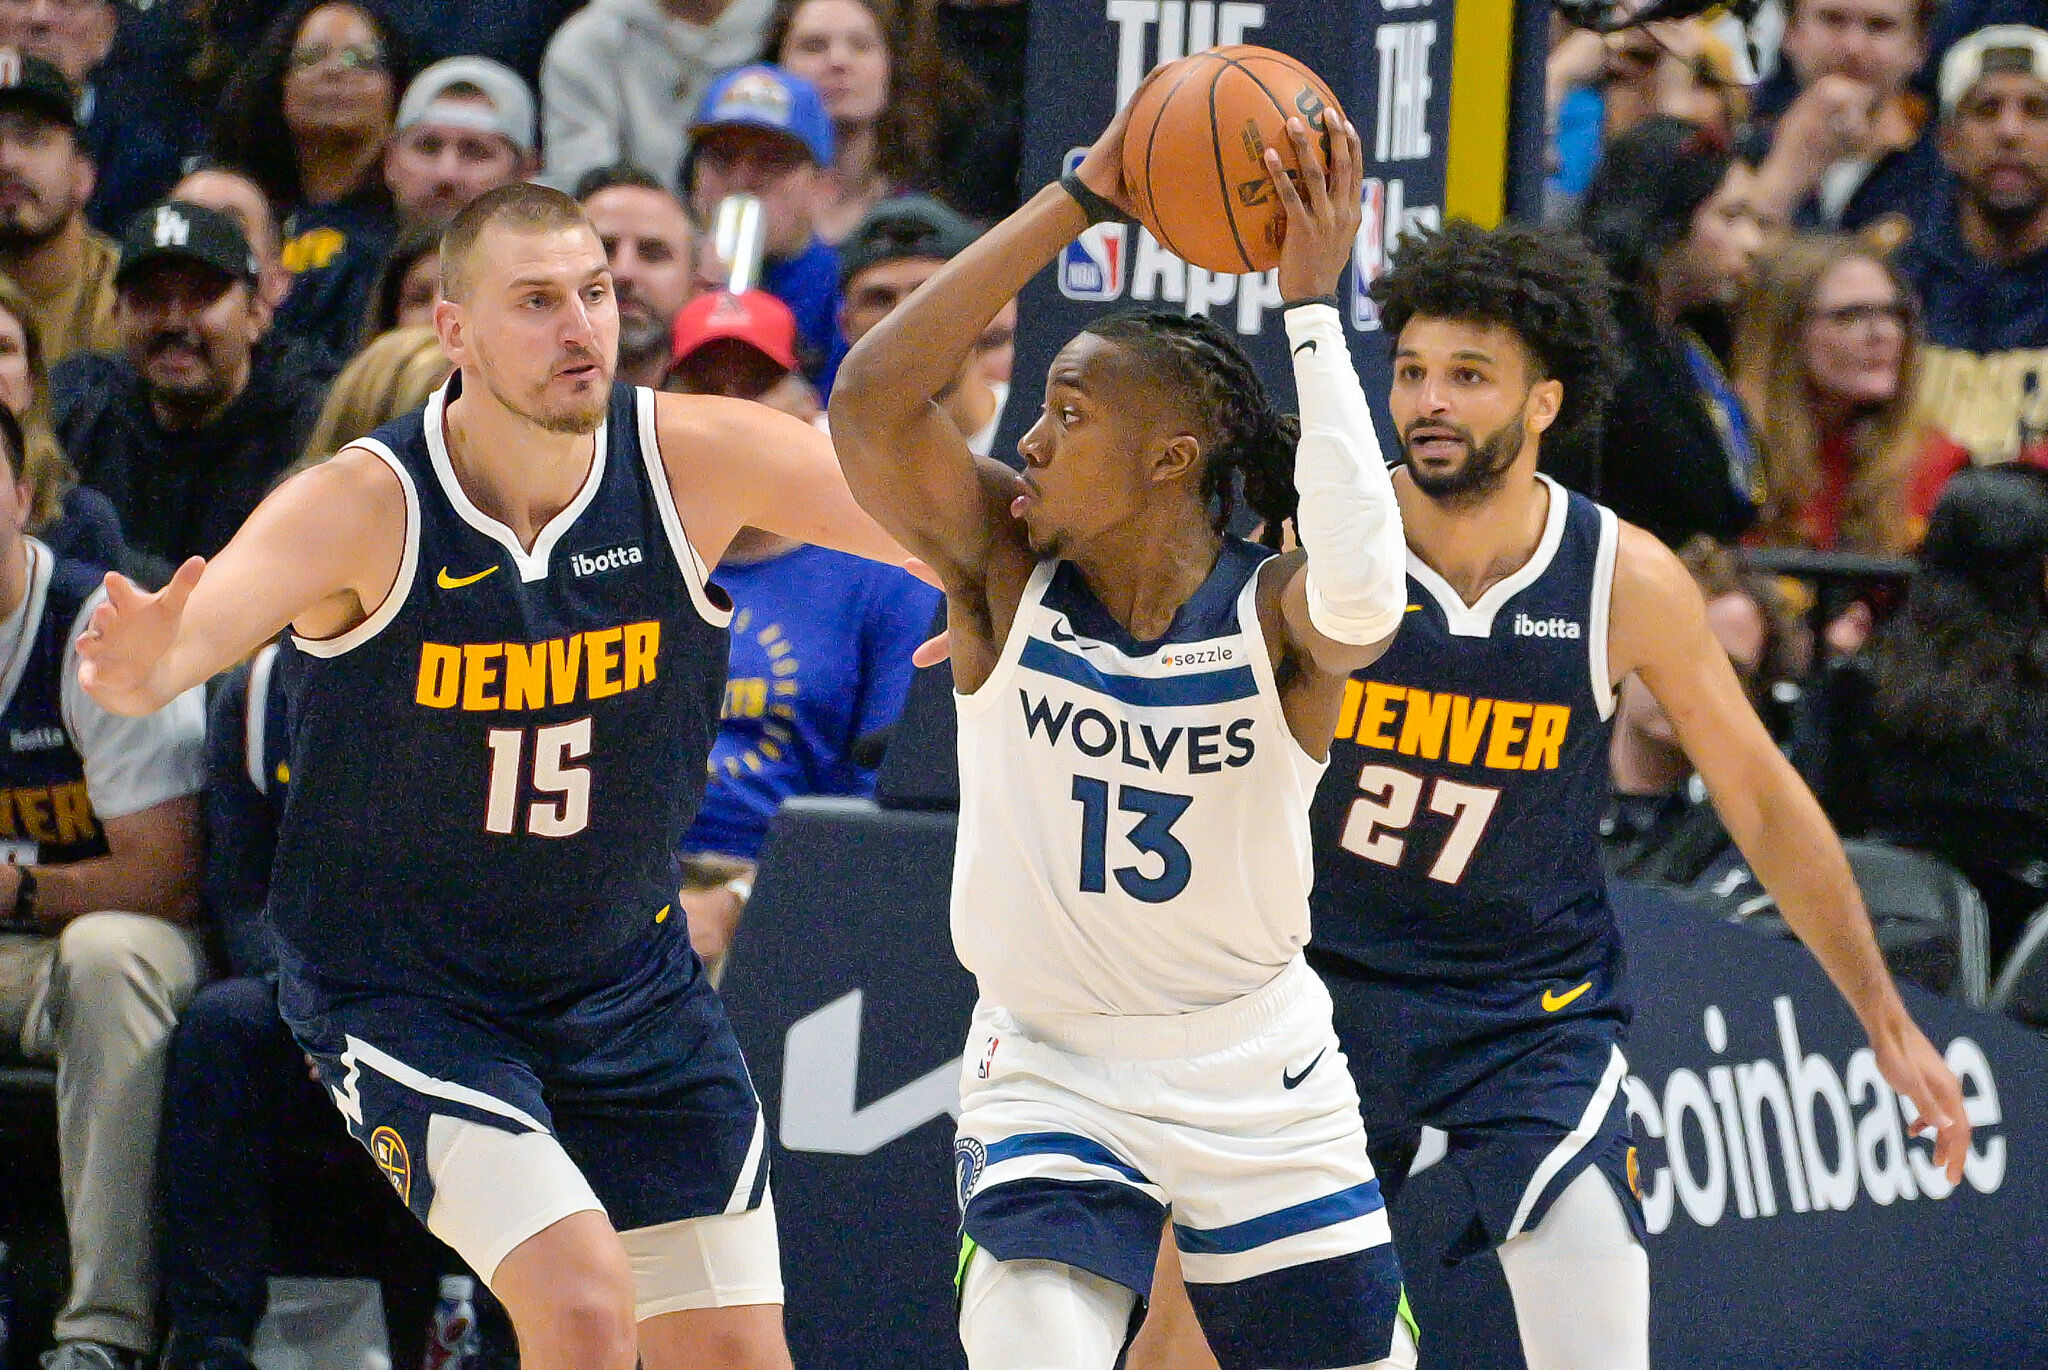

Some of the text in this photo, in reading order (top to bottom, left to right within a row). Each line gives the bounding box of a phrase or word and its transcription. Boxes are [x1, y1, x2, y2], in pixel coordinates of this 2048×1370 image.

[571, 546, 642, 577] ibotta
[415, 620, 660, 711] DENVER
[1174, 645, 1233, 666] sezzle
[1514, 612, 1580, 639] ibotta
[1019, 688, 1256, 775] WOLVES
[485, 716, 593, 838] 15
[1071, 774, 1194, 904] 13
[1341, 764, 1501, 884] 27
